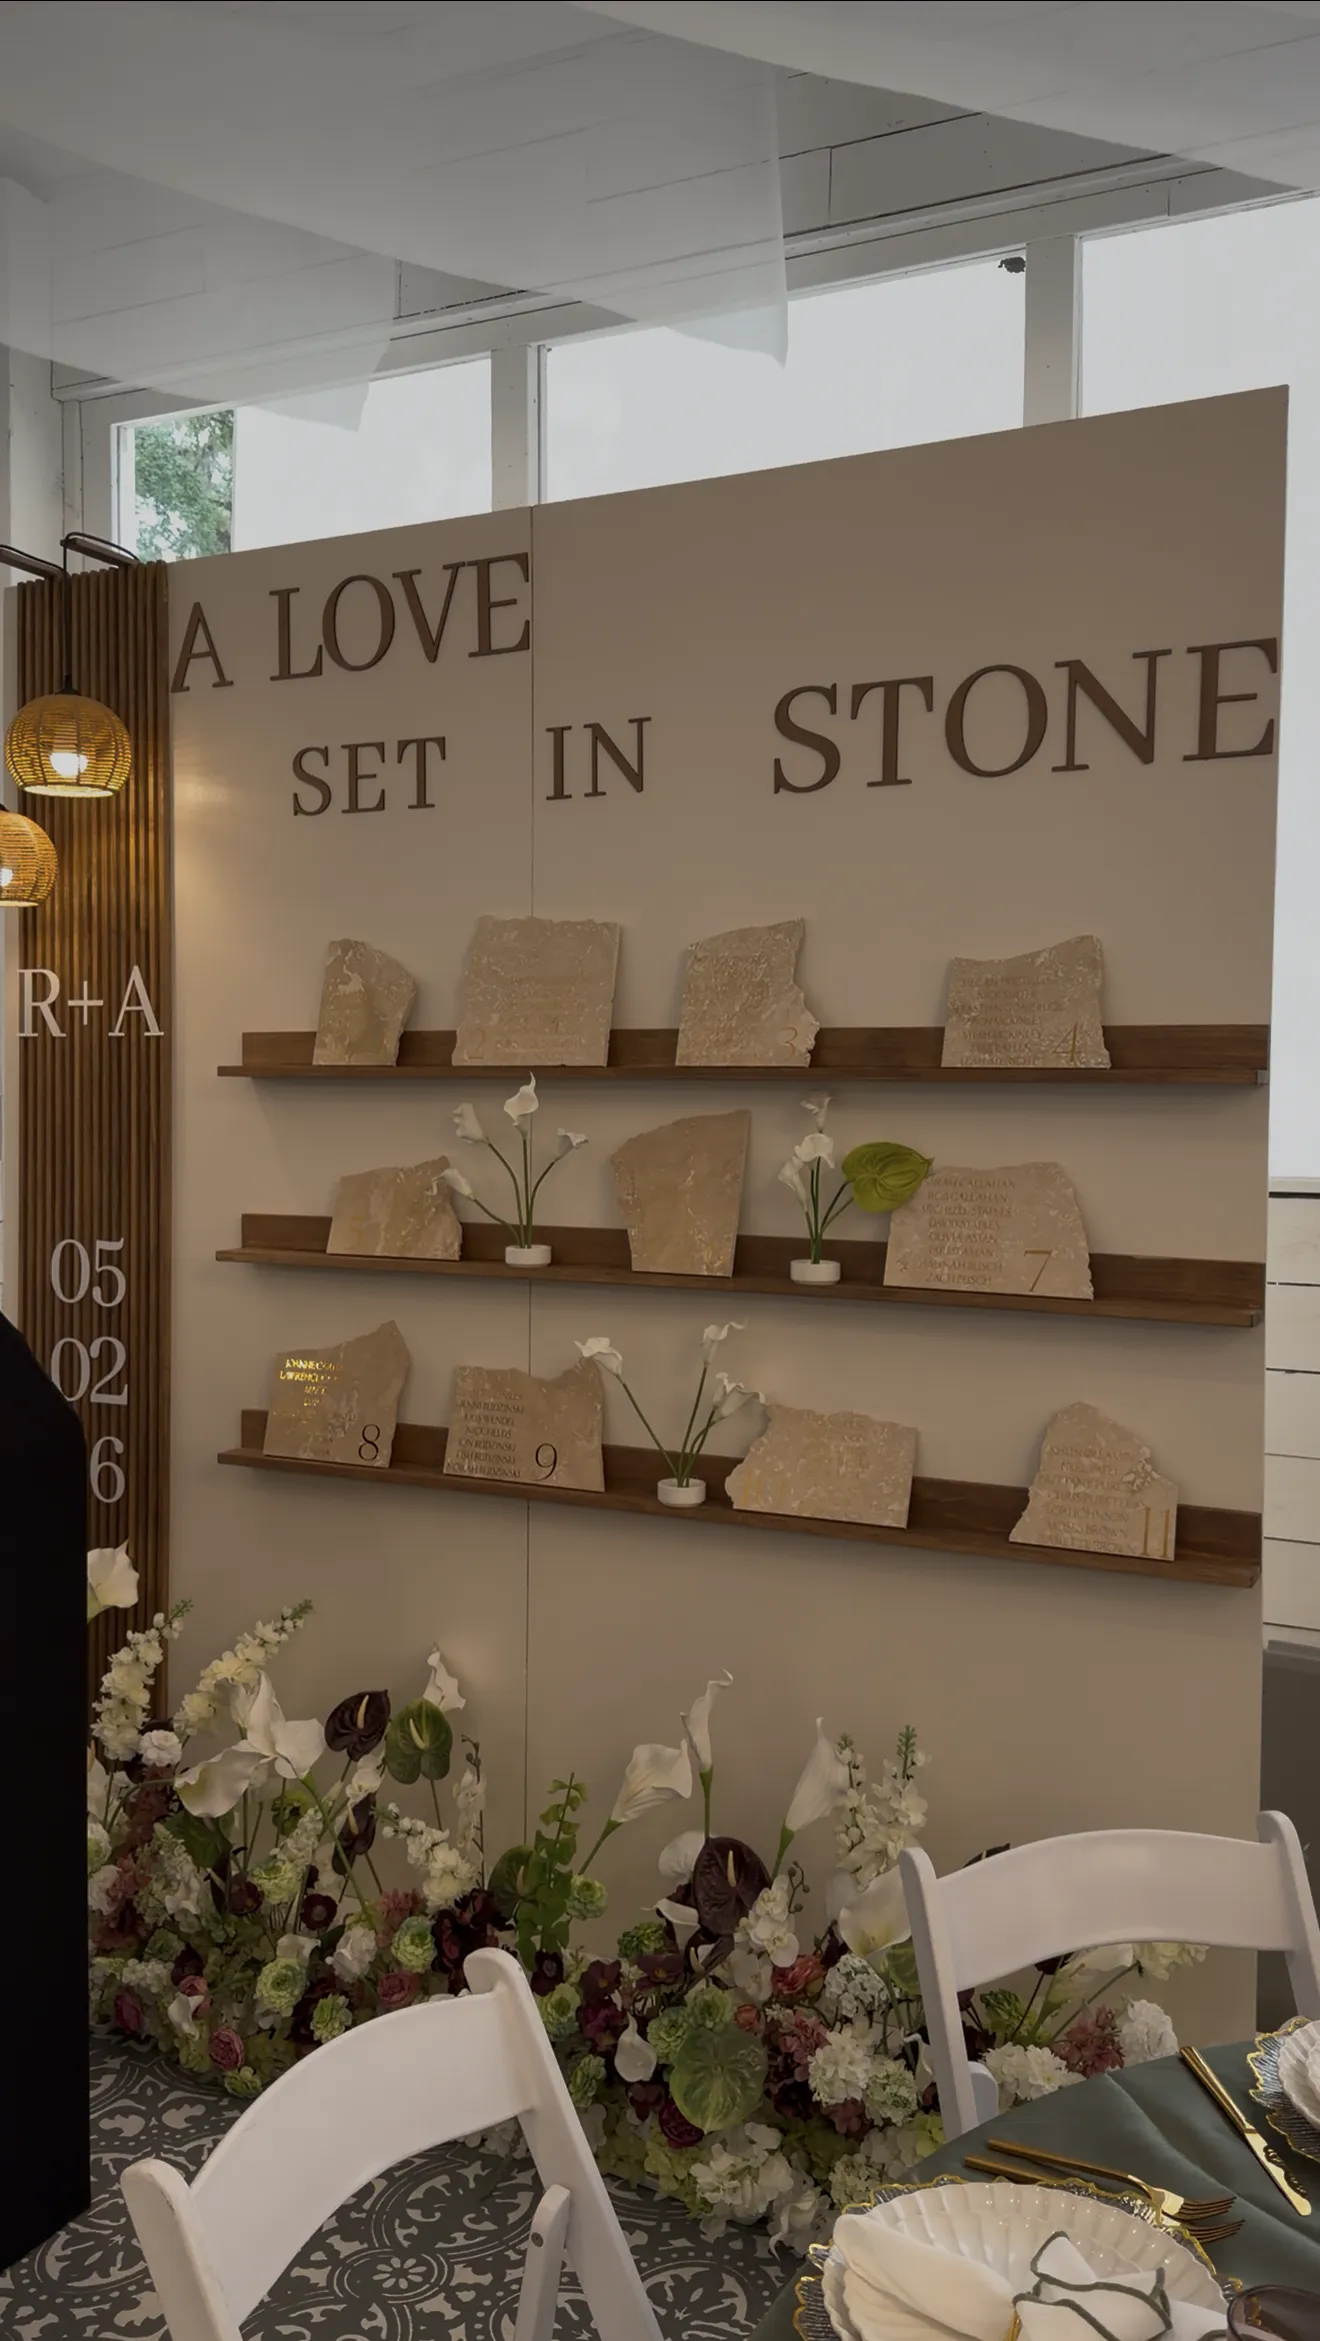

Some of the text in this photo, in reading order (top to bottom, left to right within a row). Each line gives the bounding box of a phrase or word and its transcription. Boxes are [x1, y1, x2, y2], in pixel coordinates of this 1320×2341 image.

[170, 551, 532, 694] A LOVE
[292, 637, 1279, 818] SET IN STONE
[16, 965, 165, 1038] R+A
[779, 1026, 799, 1063] 3
[1052, 1023, 1082, 1062] 4
[50, 1237, 126, 1308] 05
[1023, 1250, 1052, 1293] 7
[50, 1335, 129, 1406] 02
[89, 1435, 126, 1503] 6
[357, 1422, 381, 1462] 8
[533, 1442, 558, 1482] 9
[1140, 1506, 1172, 1558] 11
